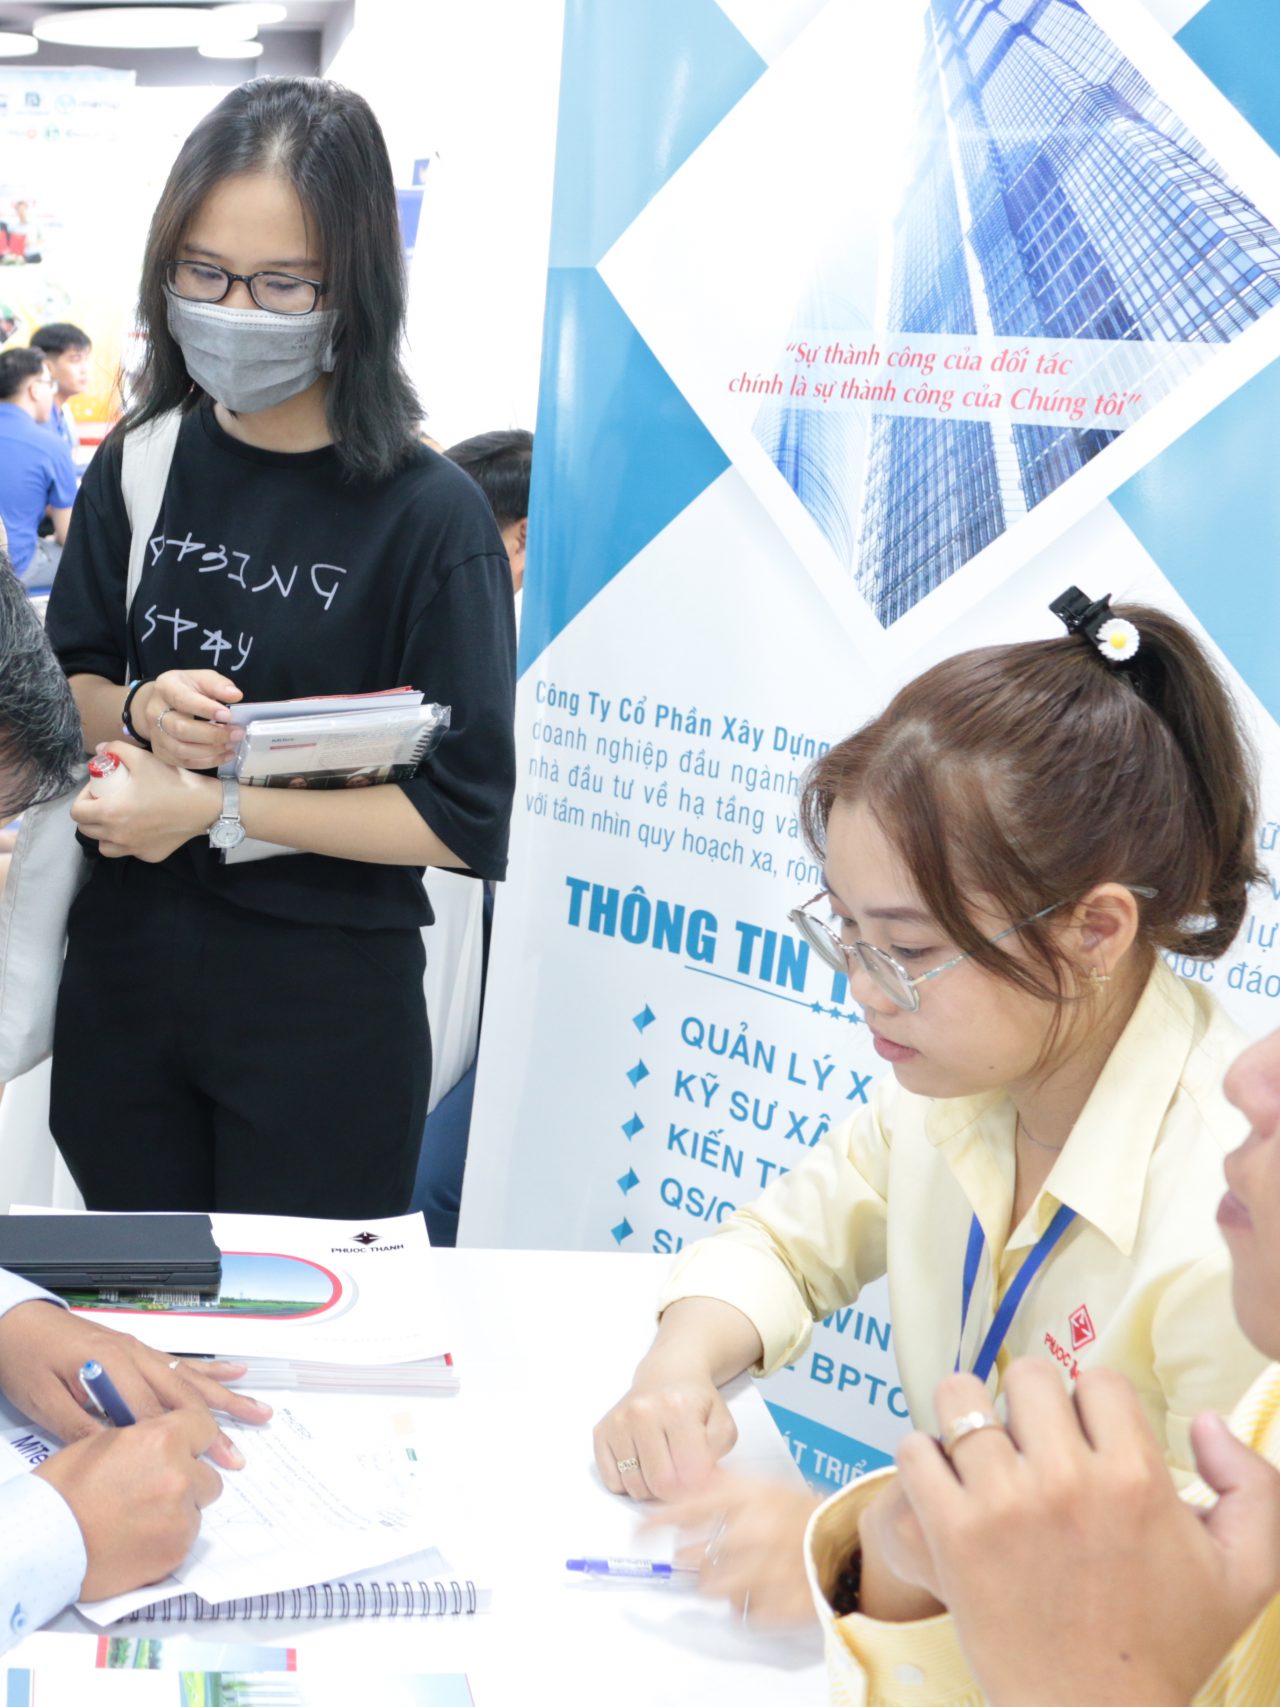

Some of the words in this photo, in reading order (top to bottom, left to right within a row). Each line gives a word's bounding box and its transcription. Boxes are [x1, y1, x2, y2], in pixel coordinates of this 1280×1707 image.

[824, 342, 880, 366] thành
[887, 346, 936, 376] công
[943, 346, 983, 371] của
[990, 347, 1030, 373] đối
[1035, 352, 1073, 375] tác
[728, 372, 783, 395] chính
[789, 374, 808, 396] là
[813, 381, 837, 403] sự
[840, 377, 897, 402] thành
[903, 383, 954, 413] công
[962, 383, 1003, 408] của
[1010, 386, 1088, 421] Chúng
[536, 680, 580, 717] Công
[588, 690, 611, 722] Ty
[619, 695, 648, 725] Cổ
[655, 704, 713, 738] Phần
[721, 714, 764, 752] Xây
[532, 718, 587, 752] doanh
[596, 736, 668, 771] nghiệp
[678, 749, 720, 780] đầu
[731, 762, 799, 798] ngành
[528, 755, 559, 783] nhà
[568, 764, 603, 794] đầu
[613, 777, 634, 800] tư
[644, 781, 668, 808] về
[678, 788, 705, 820] hạ
[716, 795, 764, 835] tầng
[526, 792, 548, 817] với
[553, 797, 585, 827] tầm
[591, 809, 631, 838] nhìn
[638, 823, 675, 853] quy
[682, 828, 744, 864] hoạch
[750, 848, 778, 878] xa,
[565, 876, 718, 965] THÔNG
[735, 920, 810, 993] TIN
[681, 1016, 776, 1074] QUẢN
[788, 1054, 835, 1091] LÝ
[674, 1069, 720, 1109] KỸ
[729, 1090, 779, 1131] SƯ
[667, 1123, 744, 1179] KIẾN
[756, 1157, 792, 1189] T
